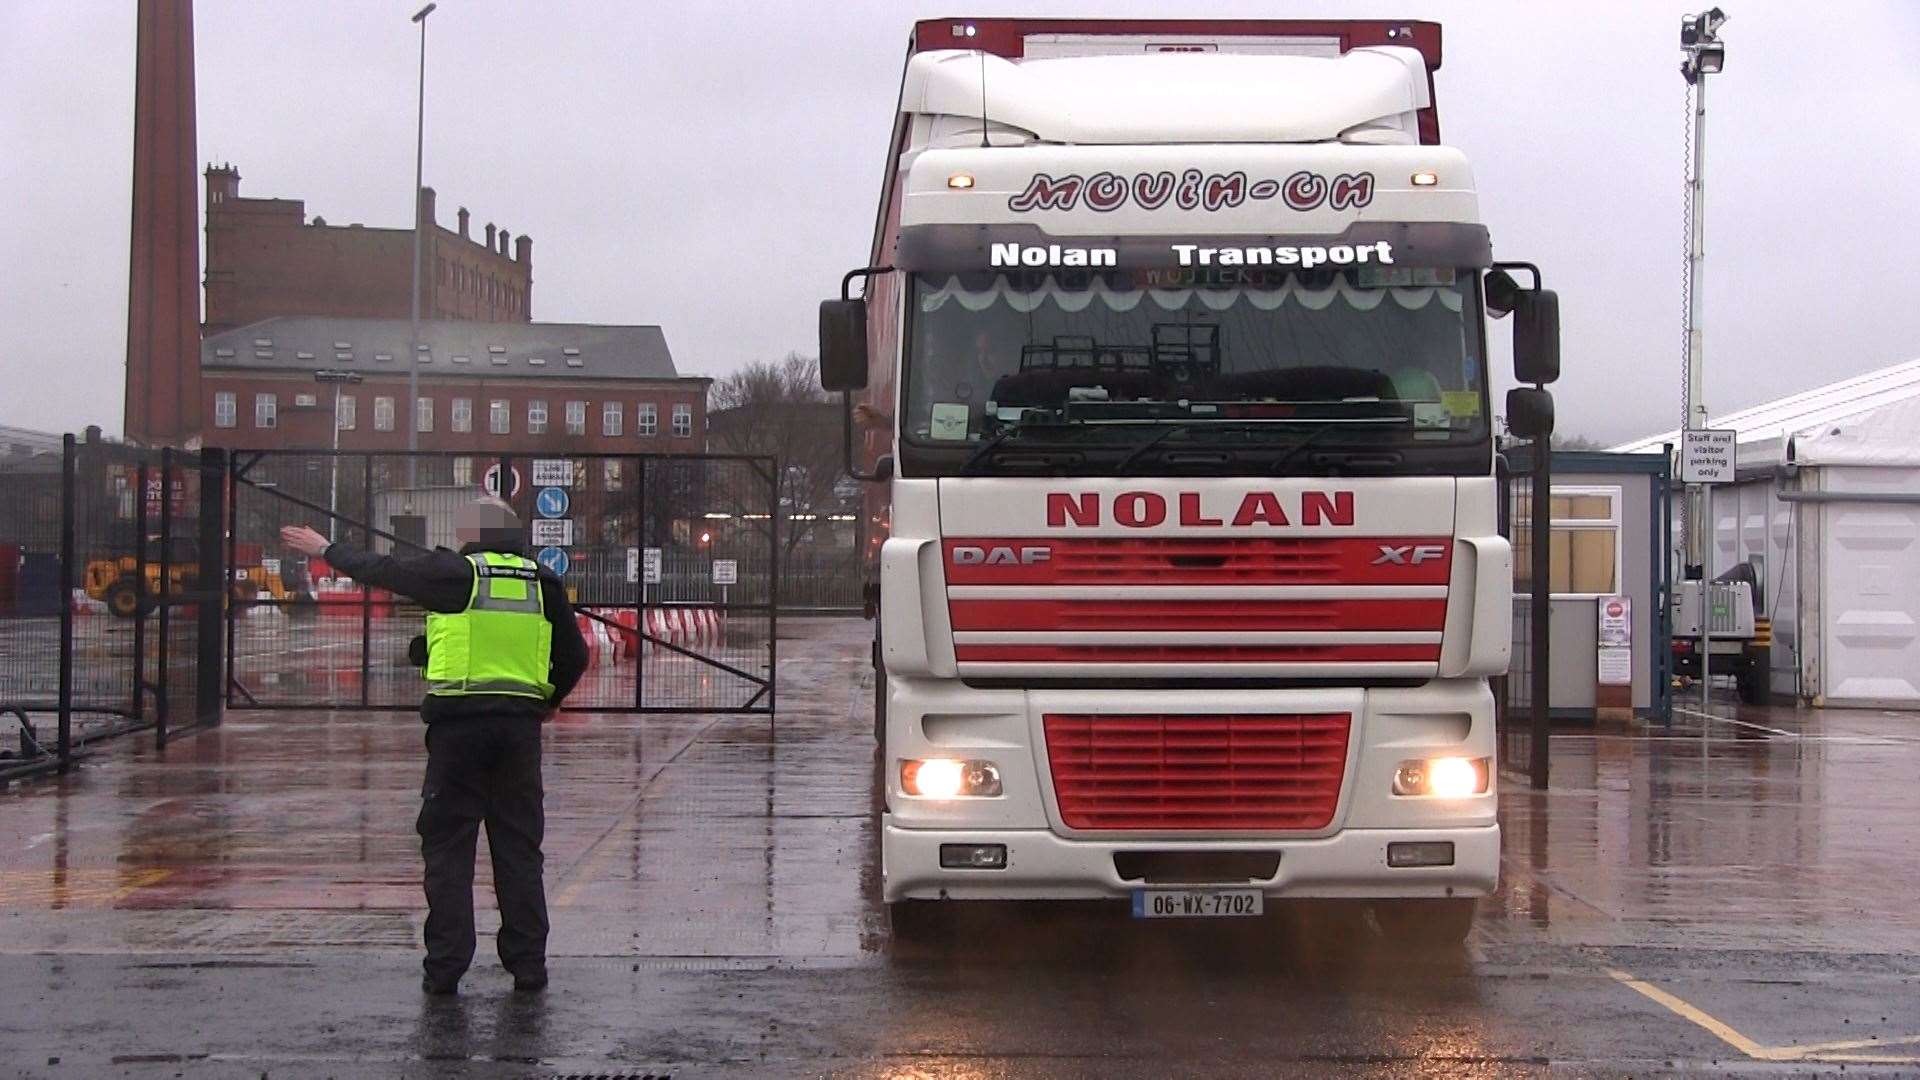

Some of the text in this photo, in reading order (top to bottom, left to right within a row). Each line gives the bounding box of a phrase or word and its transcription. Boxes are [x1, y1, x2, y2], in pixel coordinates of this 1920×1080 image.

[991, 240, 1395, 268] Nolan Transport
[1687, 433, 1710, 442] Staff
[1694, 445, 1724, 454] visitor
[1690, 457, 1728, 468] parking
[1697, 468, 1720, 478] only
[1046, 491, 1356, 527] NOLAN
[952, 545, 1446, 565] DAF XF
[1153, 894, 1255, 914] 06-WX-7702
